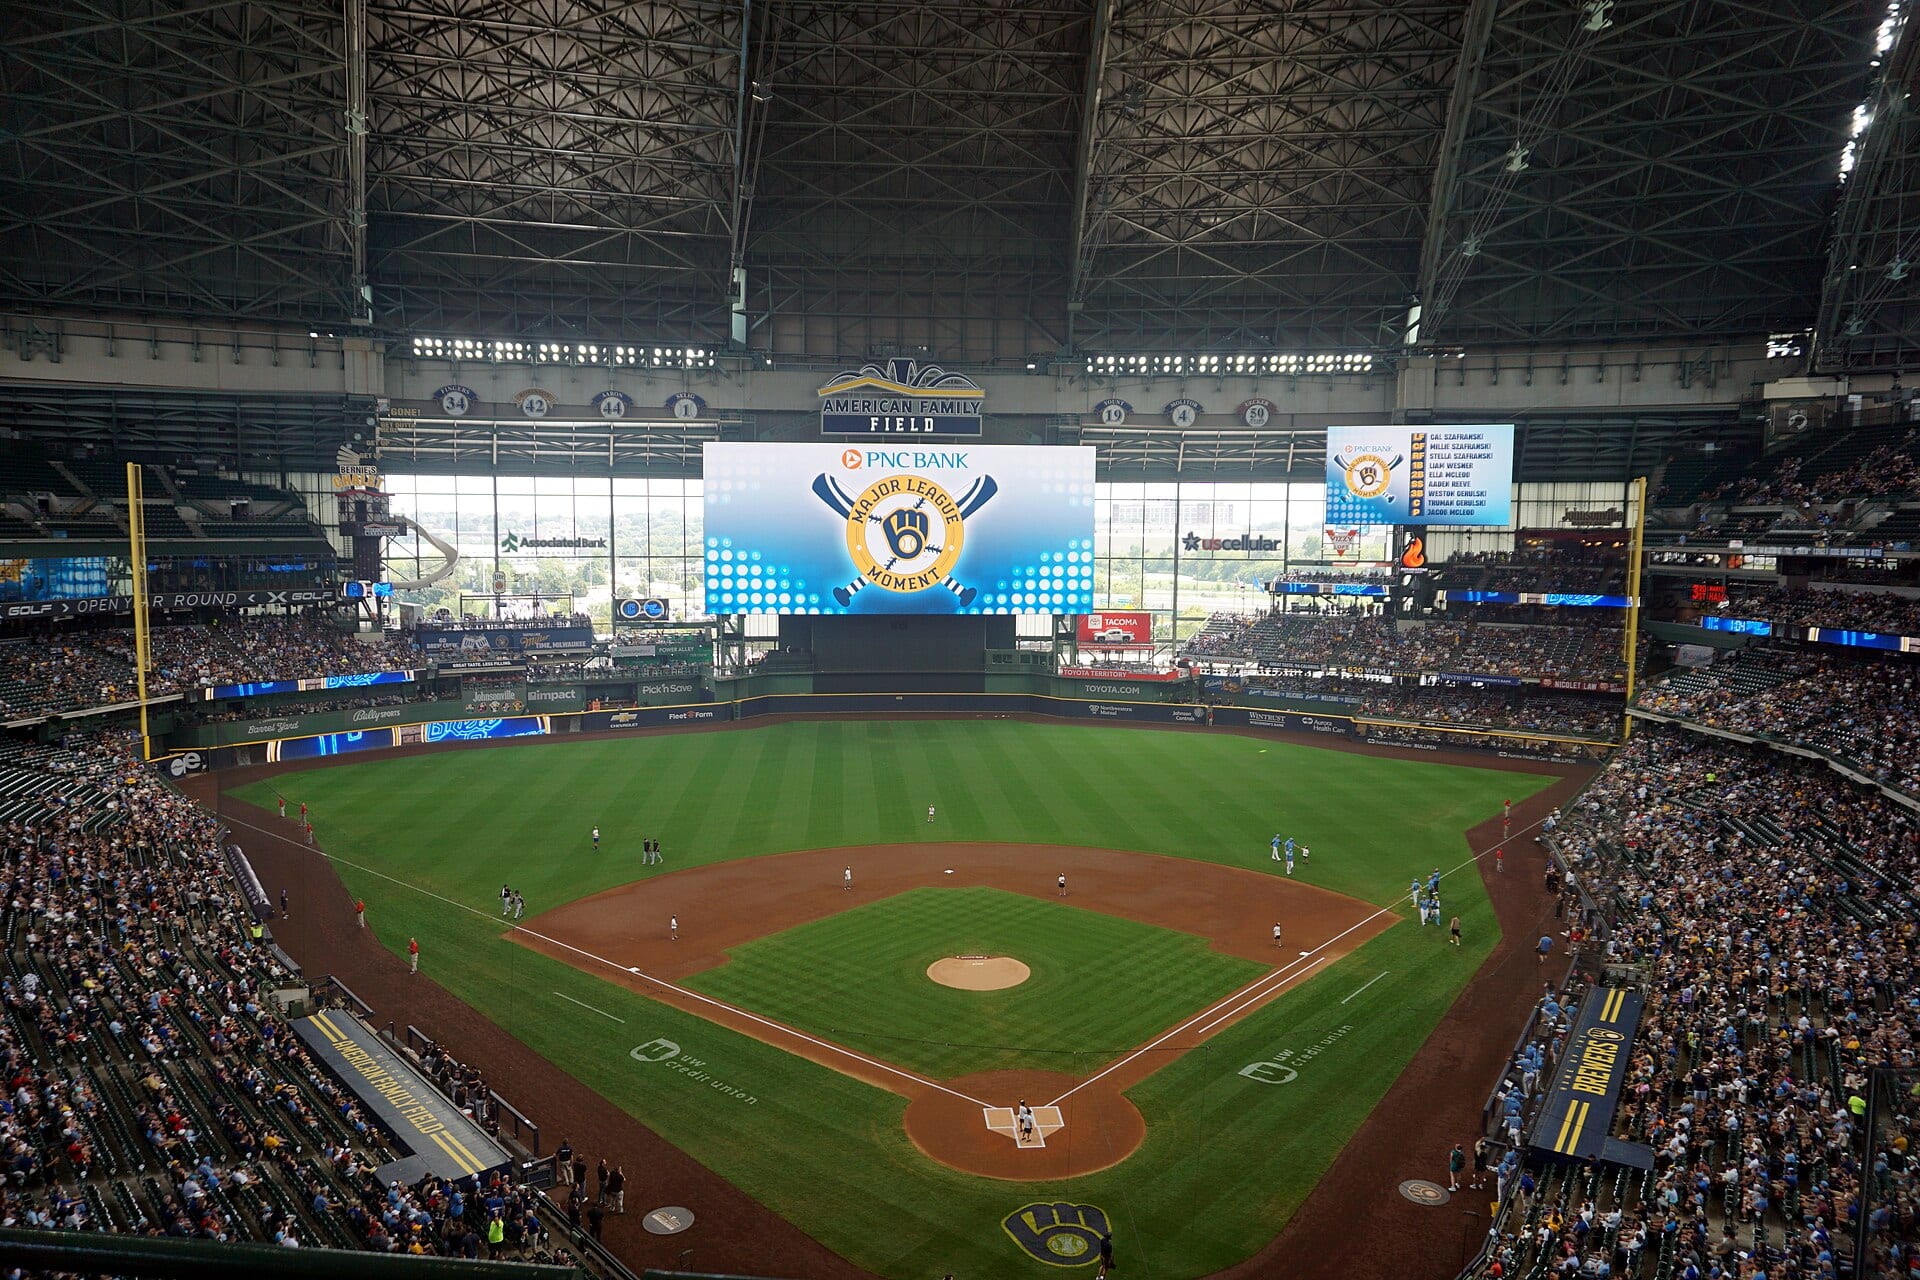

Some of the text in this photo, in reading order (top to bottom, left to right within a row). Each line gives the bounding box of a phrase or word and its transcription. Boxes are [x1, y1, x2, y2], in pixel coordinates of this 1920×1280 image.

[441, 385, 470, 395] FINGERS
[602, 391, 622, 399] AARON
[676, 392, 695, 400] SELIG
[446, 397, 465, 410] 34
[526, 400, 544, 412] 42
[603, 401, 621, 414] 44
[823, 399, 981, 414] AMERICAN FAMILY
[1170, 400, 1199, 408] MOLITOR
[391, 408, 420, 416] GONE!
[682, 405, 690, 417] 1
[1105, 409, 1122, 421] 19
[1178, 409, 1188, 421] 4
[1250, 408, 1264, 418] 50
[870, 417, 934, 432] FIELD
[1354, 445, 1393, 453] PNC BANK
[1412, 442, 1425, 450] CF
[866, 452, 969, 469] PNC BANK
[1412, 451, 1425, 459] RF
[340, 466, 377, 474] BERNIE'S
[1412, 461, 1424, 469] 1B
[332, 475, 384, 488] CHALET
[1411, 480, 1424, 488] SS
[1410, 489, 1424, 497] 3B
[852, 478, 960, 525] MAJOR LEAGUE
[1412, 499, 1420, 507] C
[1412, 508, 1420, 516] P
[1561, 507, 1624, 522] Johnsonville
[519, 537, 607, 548] Associated Bank
[1202, 534, 1282, 551] uscellular
[1331, 535, 1353, 543] VIZZY
[867, 565, 940, 591] MOMENT
[292, 591, 333, 600] GOLF
[77, 593, 237, 612] OPEN YR ROUND
[8, 604, 52, 616] GOLF
[1105, 618, 1138, 626] TACOMA
[520, 634, 549, 649] Miller
[1091, 670, 1127, 678] TERRITORY
[1348, 666, 1363, 674] 620
[1364, 667, 1391, 675] WTMJ
[642, 684, 661, 694] Pick
[670, 684, 692, 693] Save
[1085, 685, 1140, 694] TOYOTA.COM
[1554, 681, 1598, 691] NICOLET LAW
[473, 689, 515, 702] Johnsonville
[536, 689, 576, 701] impact
[353, 710, 400, 722] Bally SPORTS
[1249, 712, 1286, 722] WINTRUST
[248, 721, 299, 734] Barrel Yard
[1320, 1024, 1354, 1045] union
[680, 1054, 706, 1067] uw
[1273, 1048, 1295, 1061] uw
[1572, 1039, 1619, 1096] BREWERS
[332, 1039, 444, 1134] AMERICAN FAMILY FIELD
[665, 1060, 758, 1105] credit union
